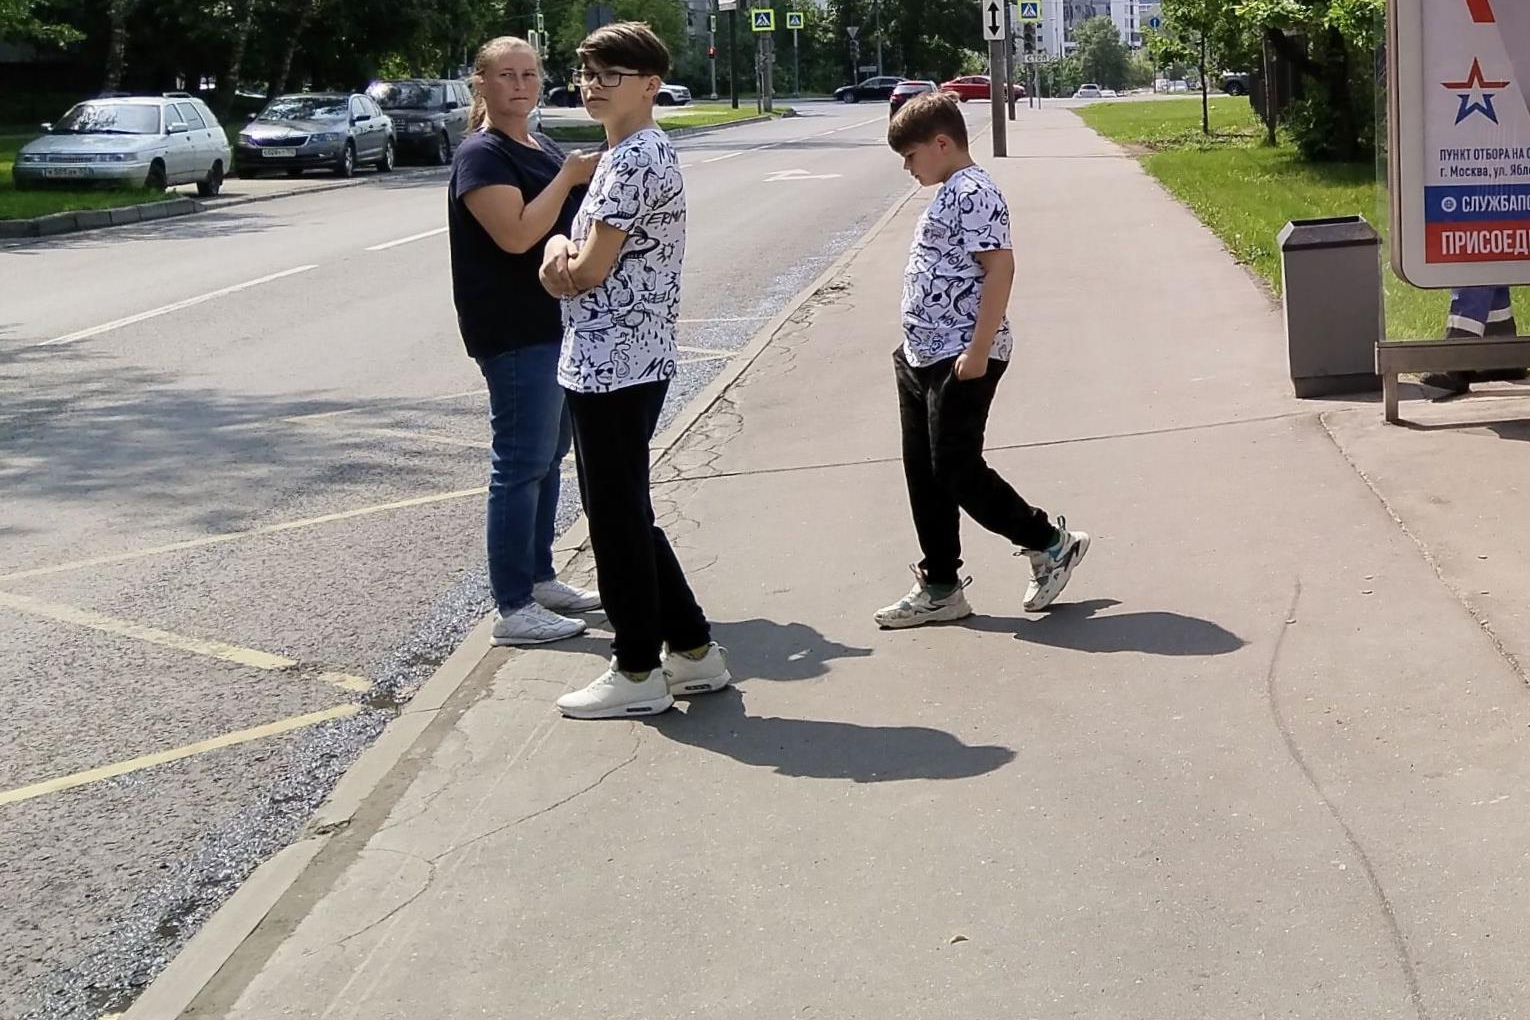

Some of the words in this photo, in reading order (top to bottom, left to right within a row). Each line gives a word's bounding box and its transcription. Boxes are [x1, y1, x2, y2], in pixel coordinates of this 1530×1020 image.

[1439, 148, 1471, 161] ПУНКТ
[1473, 147, 1510, 160] ОТБОРА
[1512, 146, 1525, 159] НА
[1440, 167, 1448, 178] г.
[1450, 165, 1492, 178] Москва,
[1493, 166, 1508, 179] ул.
